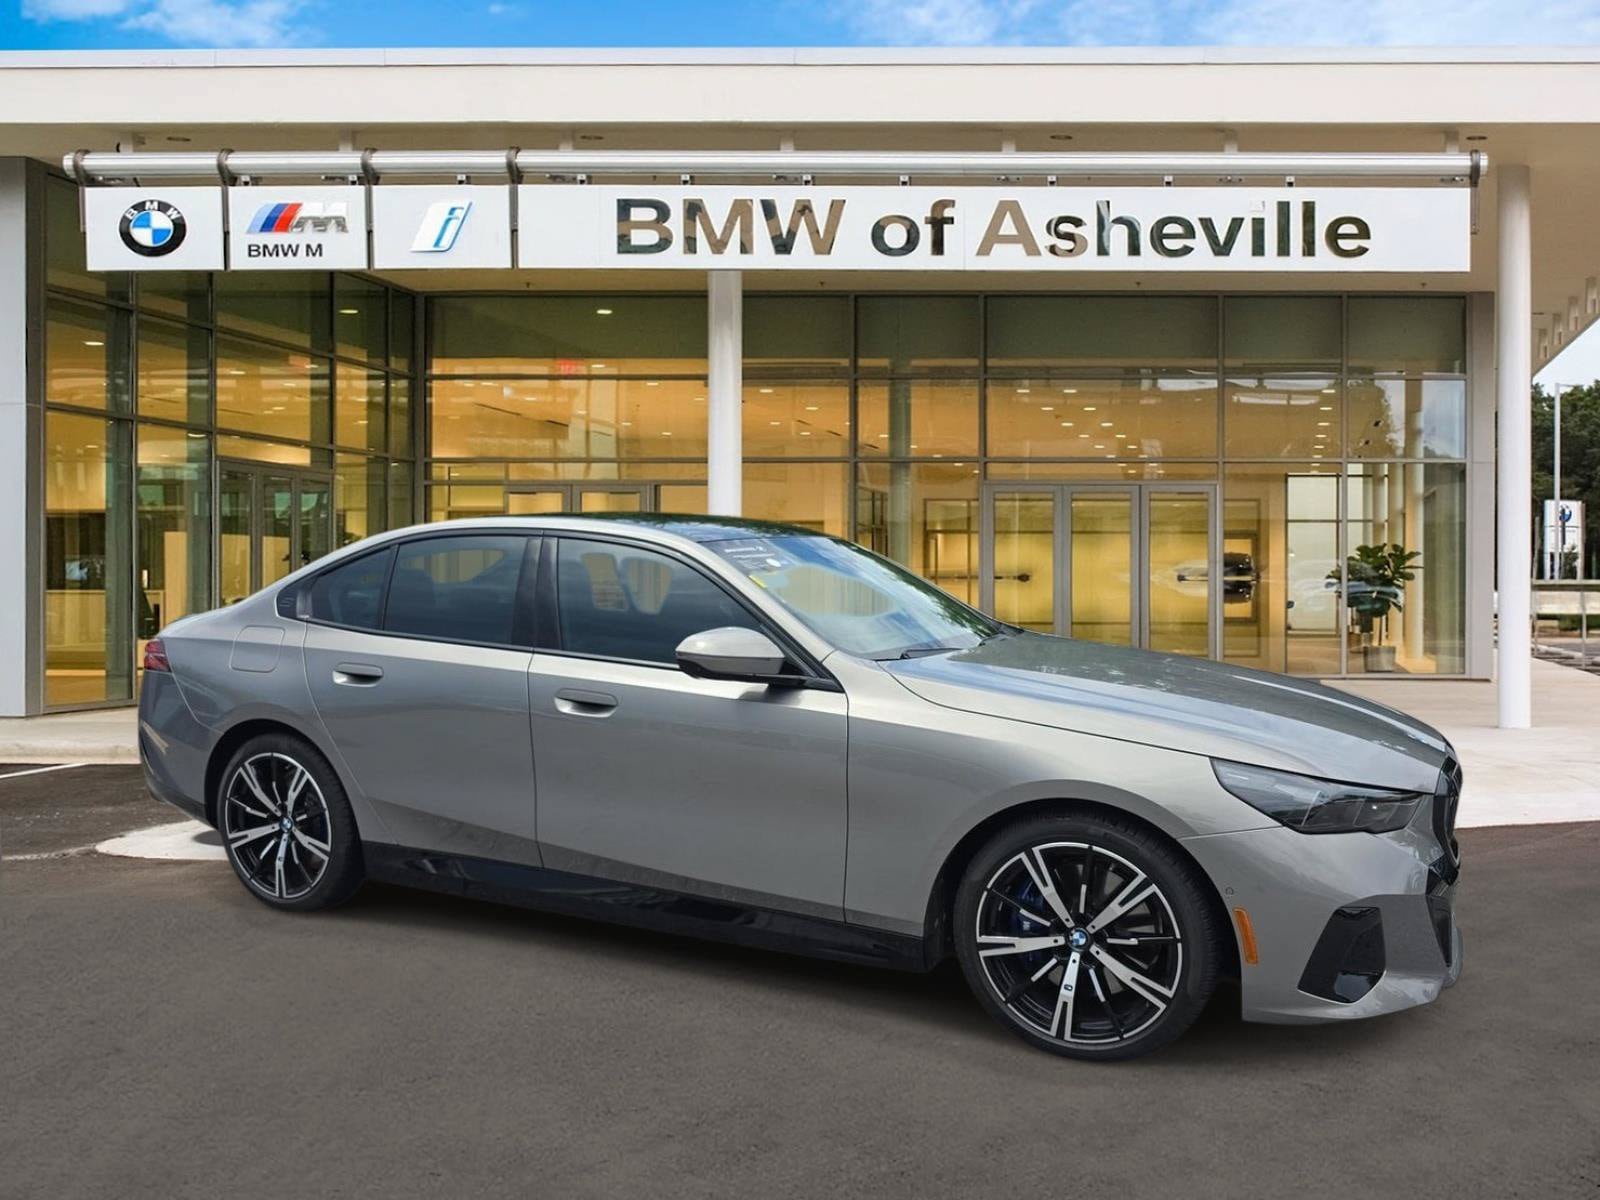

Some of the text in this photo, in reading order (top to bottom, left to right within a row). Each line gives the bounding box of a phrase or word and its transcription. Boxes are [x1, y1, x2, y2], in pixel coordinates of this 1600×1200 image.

[124, 200, 181, 220] BMW
[616, 198, 1371, 257] BMW of Asheville
[247, 243, 323, 258] BMW M
